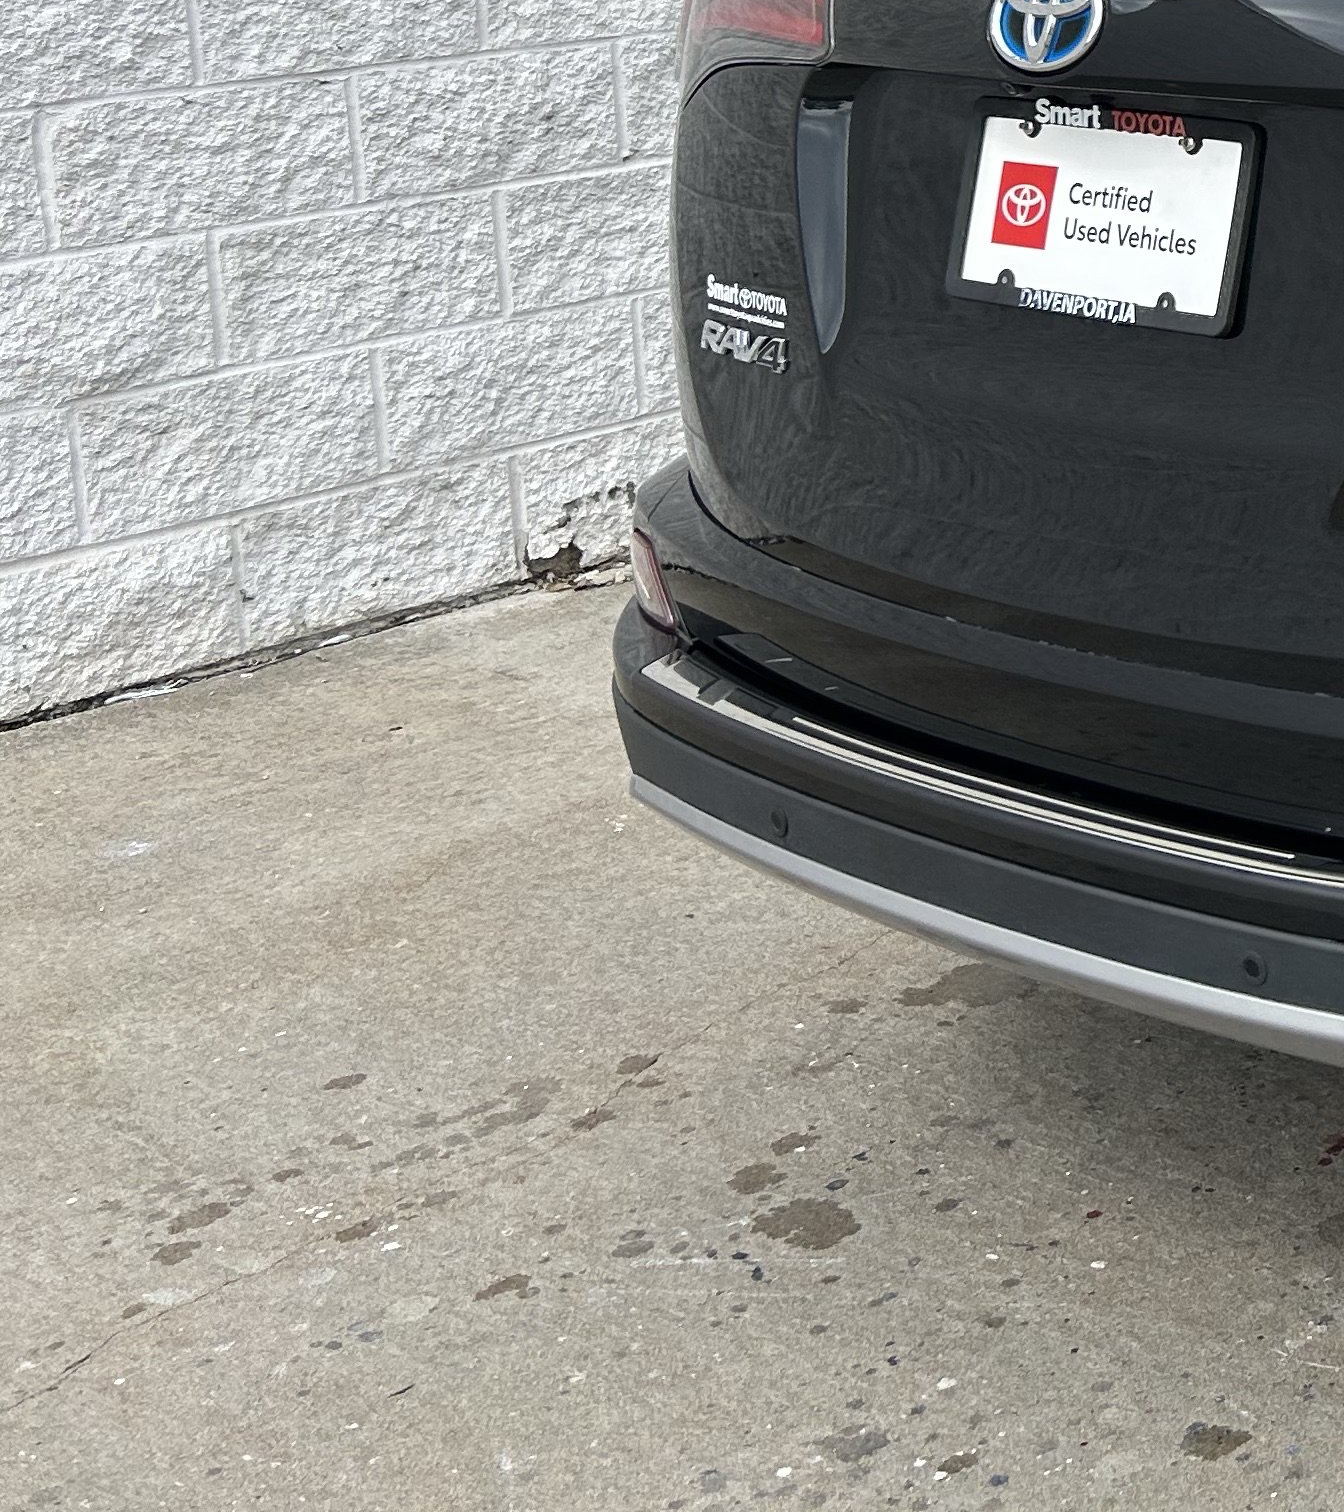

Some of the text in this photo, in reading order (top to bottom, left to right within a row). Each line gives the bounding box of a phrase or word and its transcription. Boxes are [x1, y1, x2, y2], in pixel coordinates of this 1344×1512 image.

[1034, 98, 1187, 137] Smart TOYOTA
[1069, 182, 1153, 213] Certified
[1063, 216, 1197, 256] Used Vehicles
[706, 273, 739, 304] Smart
[751, 290, 788, 317] TOYOTA
[700, 319, 790, 375] RAV4
